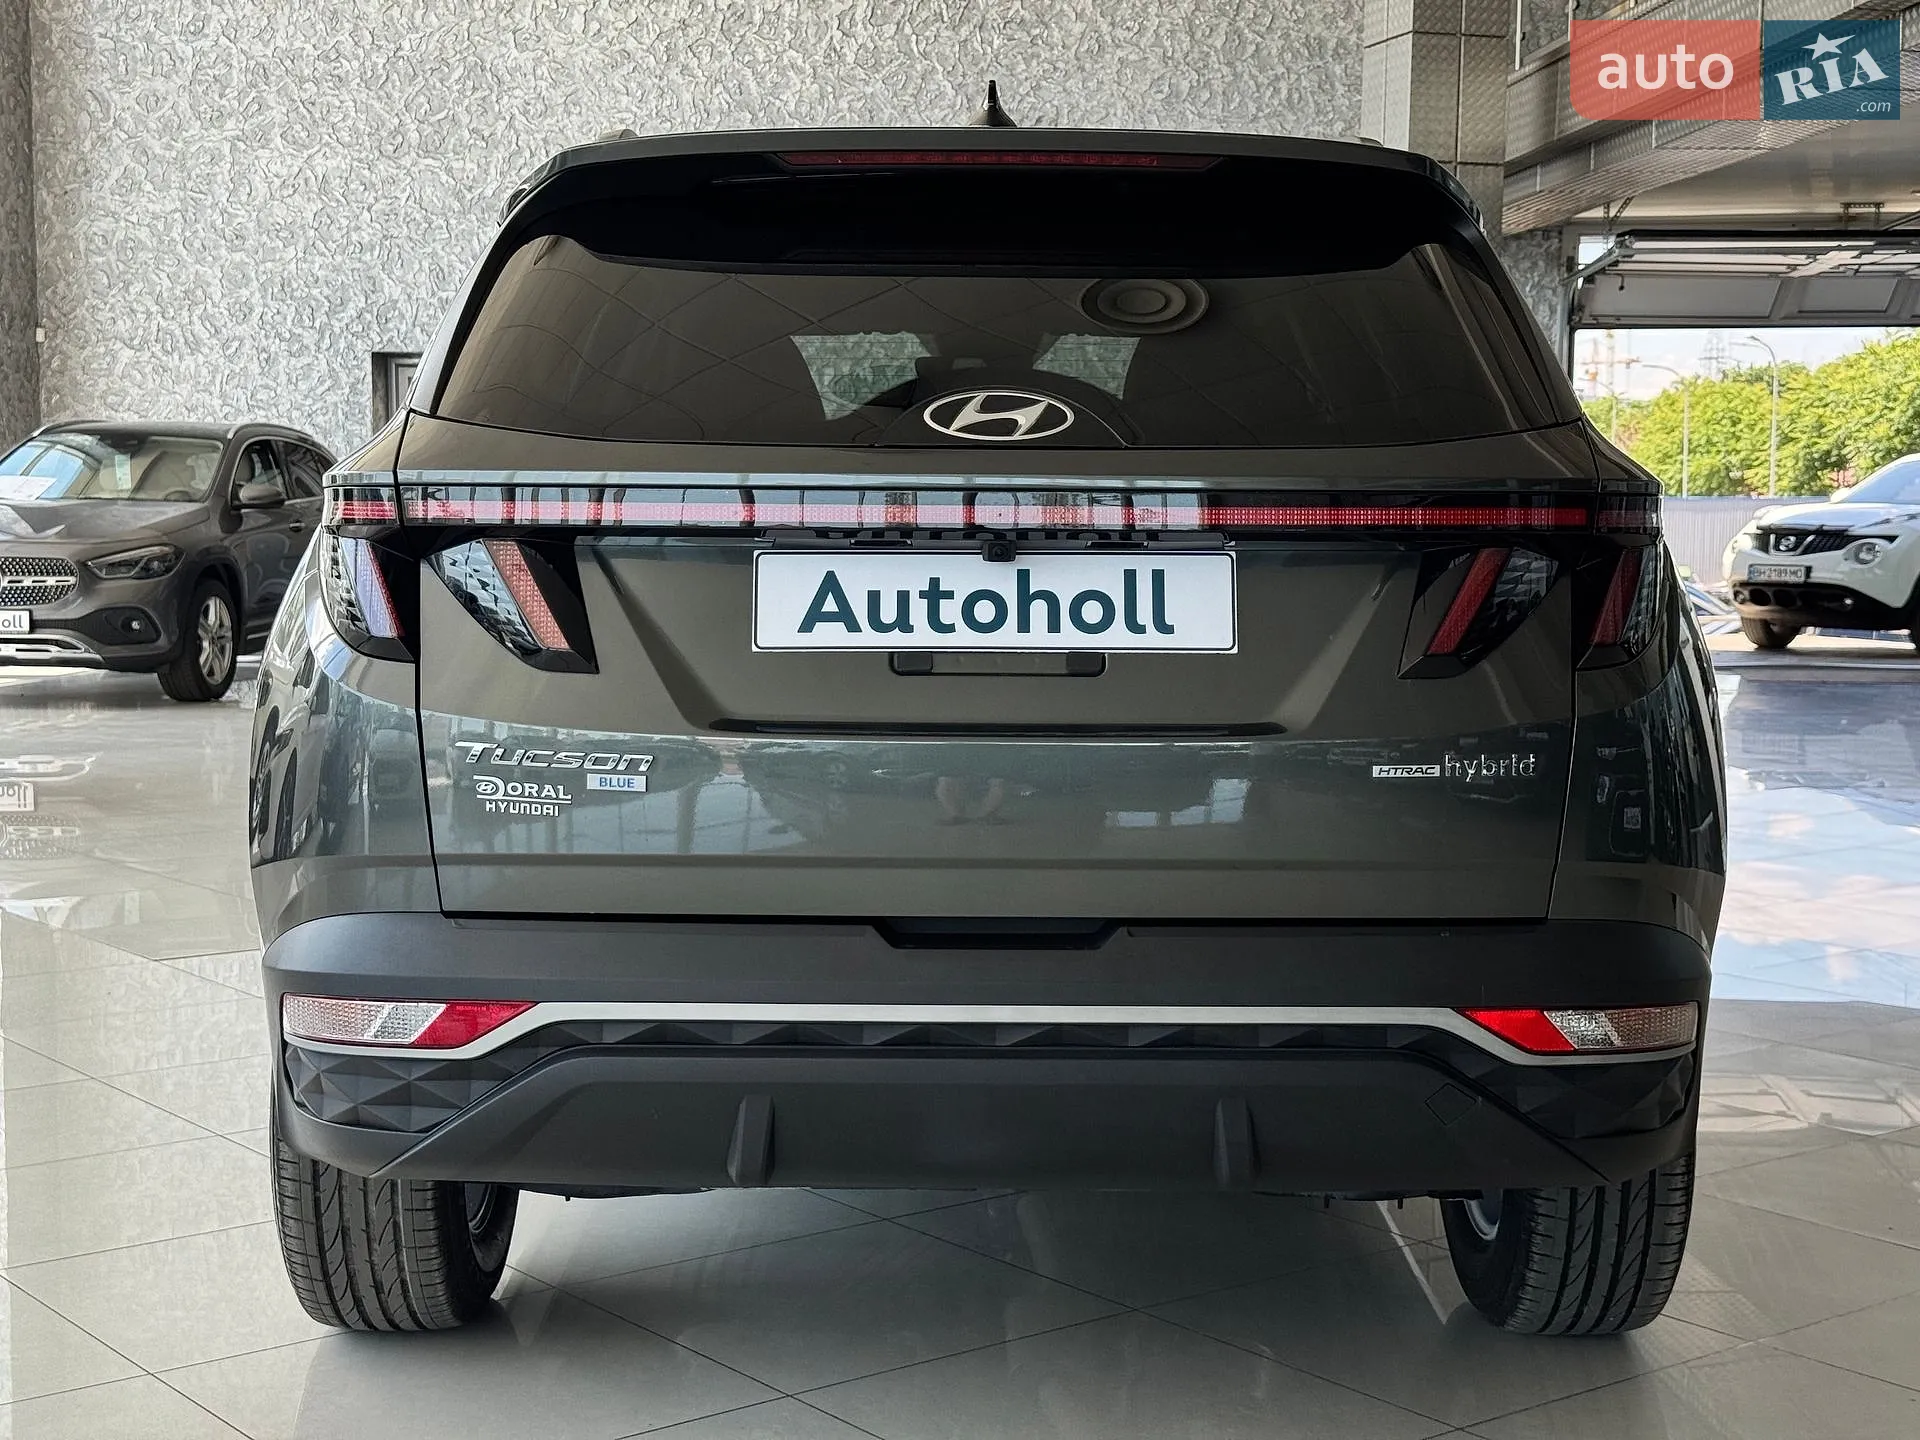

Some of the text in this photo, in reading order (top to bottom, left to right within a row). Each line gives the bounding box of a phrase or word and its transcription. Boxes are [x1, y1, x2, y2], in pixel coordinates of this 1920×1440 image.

[797, 568, 1175, 635] Autoholl
[455, 741, 654, 772] TUCSON
[1378, 753, 1536, 783] HTRAC hybrid
[473, 775, 572, 800] DORAL
[599, 776, 636, 789] BLUE
[485, 801, 559, 817] HYUNDAI
